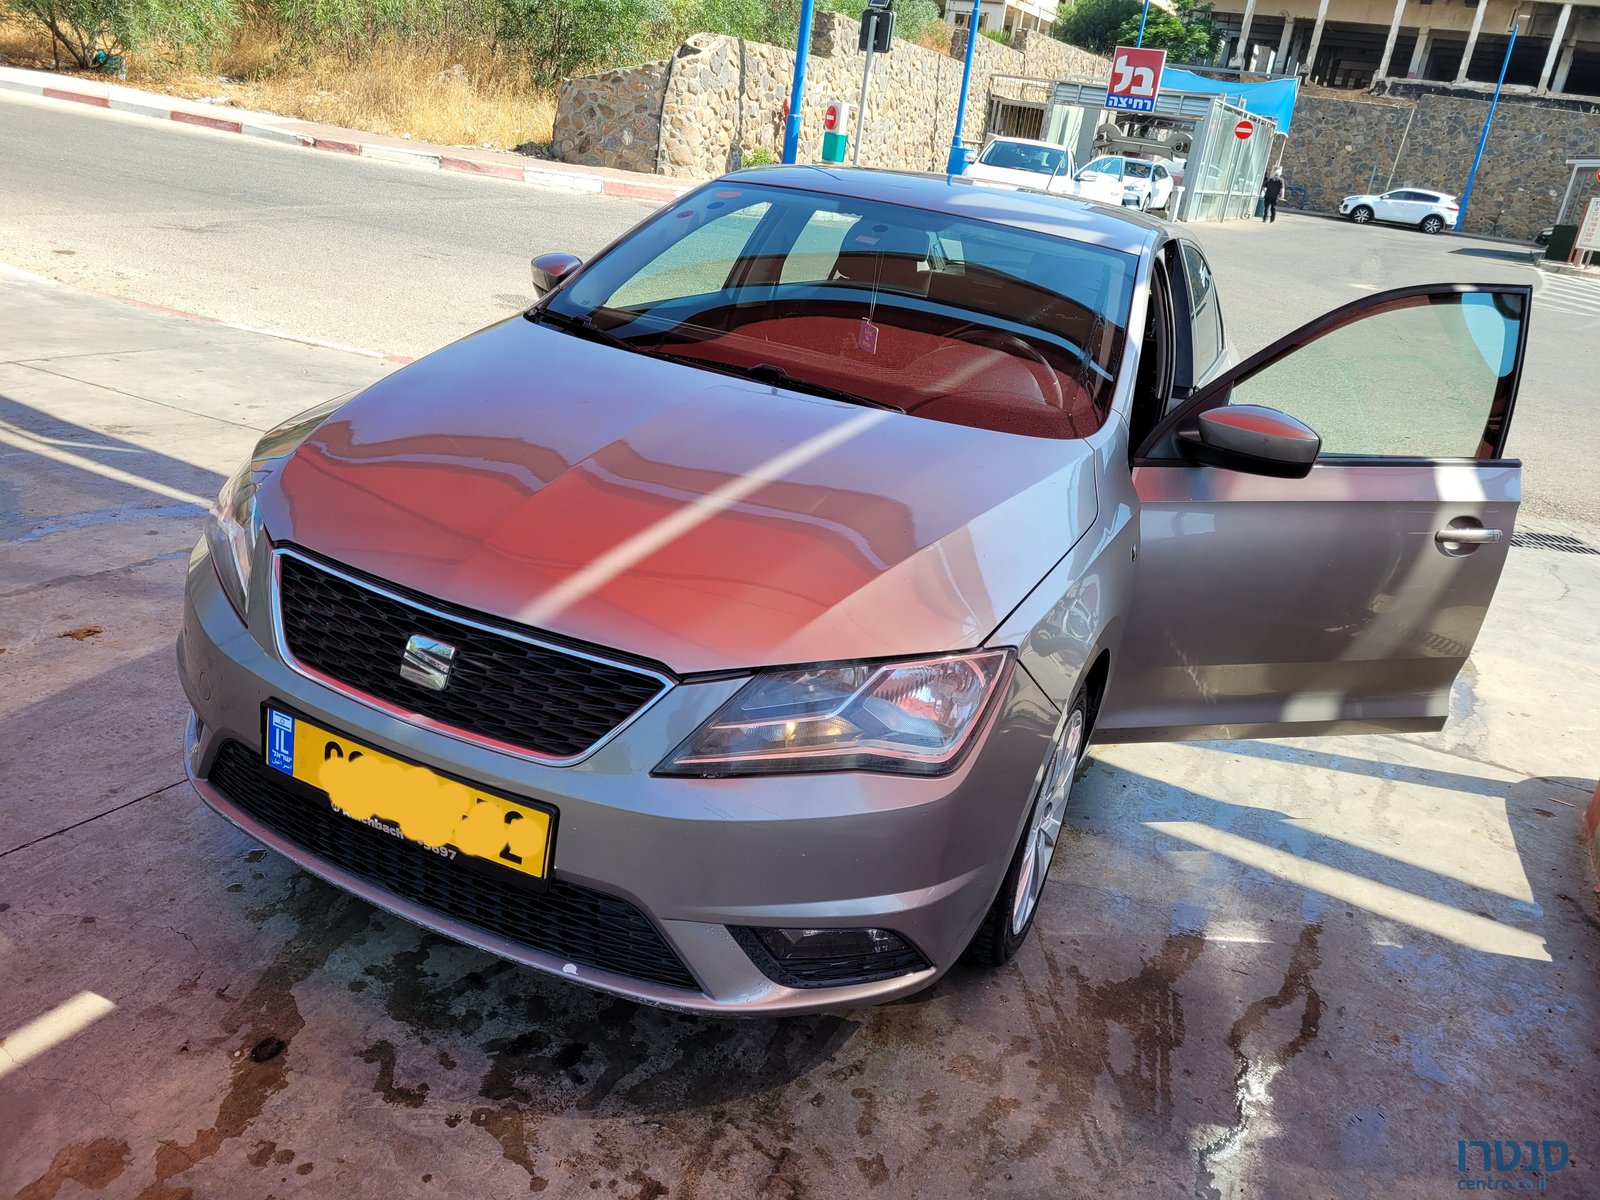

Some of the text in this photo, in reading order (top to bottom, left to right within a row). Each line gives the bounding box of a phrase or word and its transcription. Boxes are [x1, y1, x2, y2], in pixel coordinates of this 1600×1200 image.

[1114, 55, 1154, 96] בל
[1108, 96, 1152, 110] רחיצה
[275, 728, 289, 755] IL
